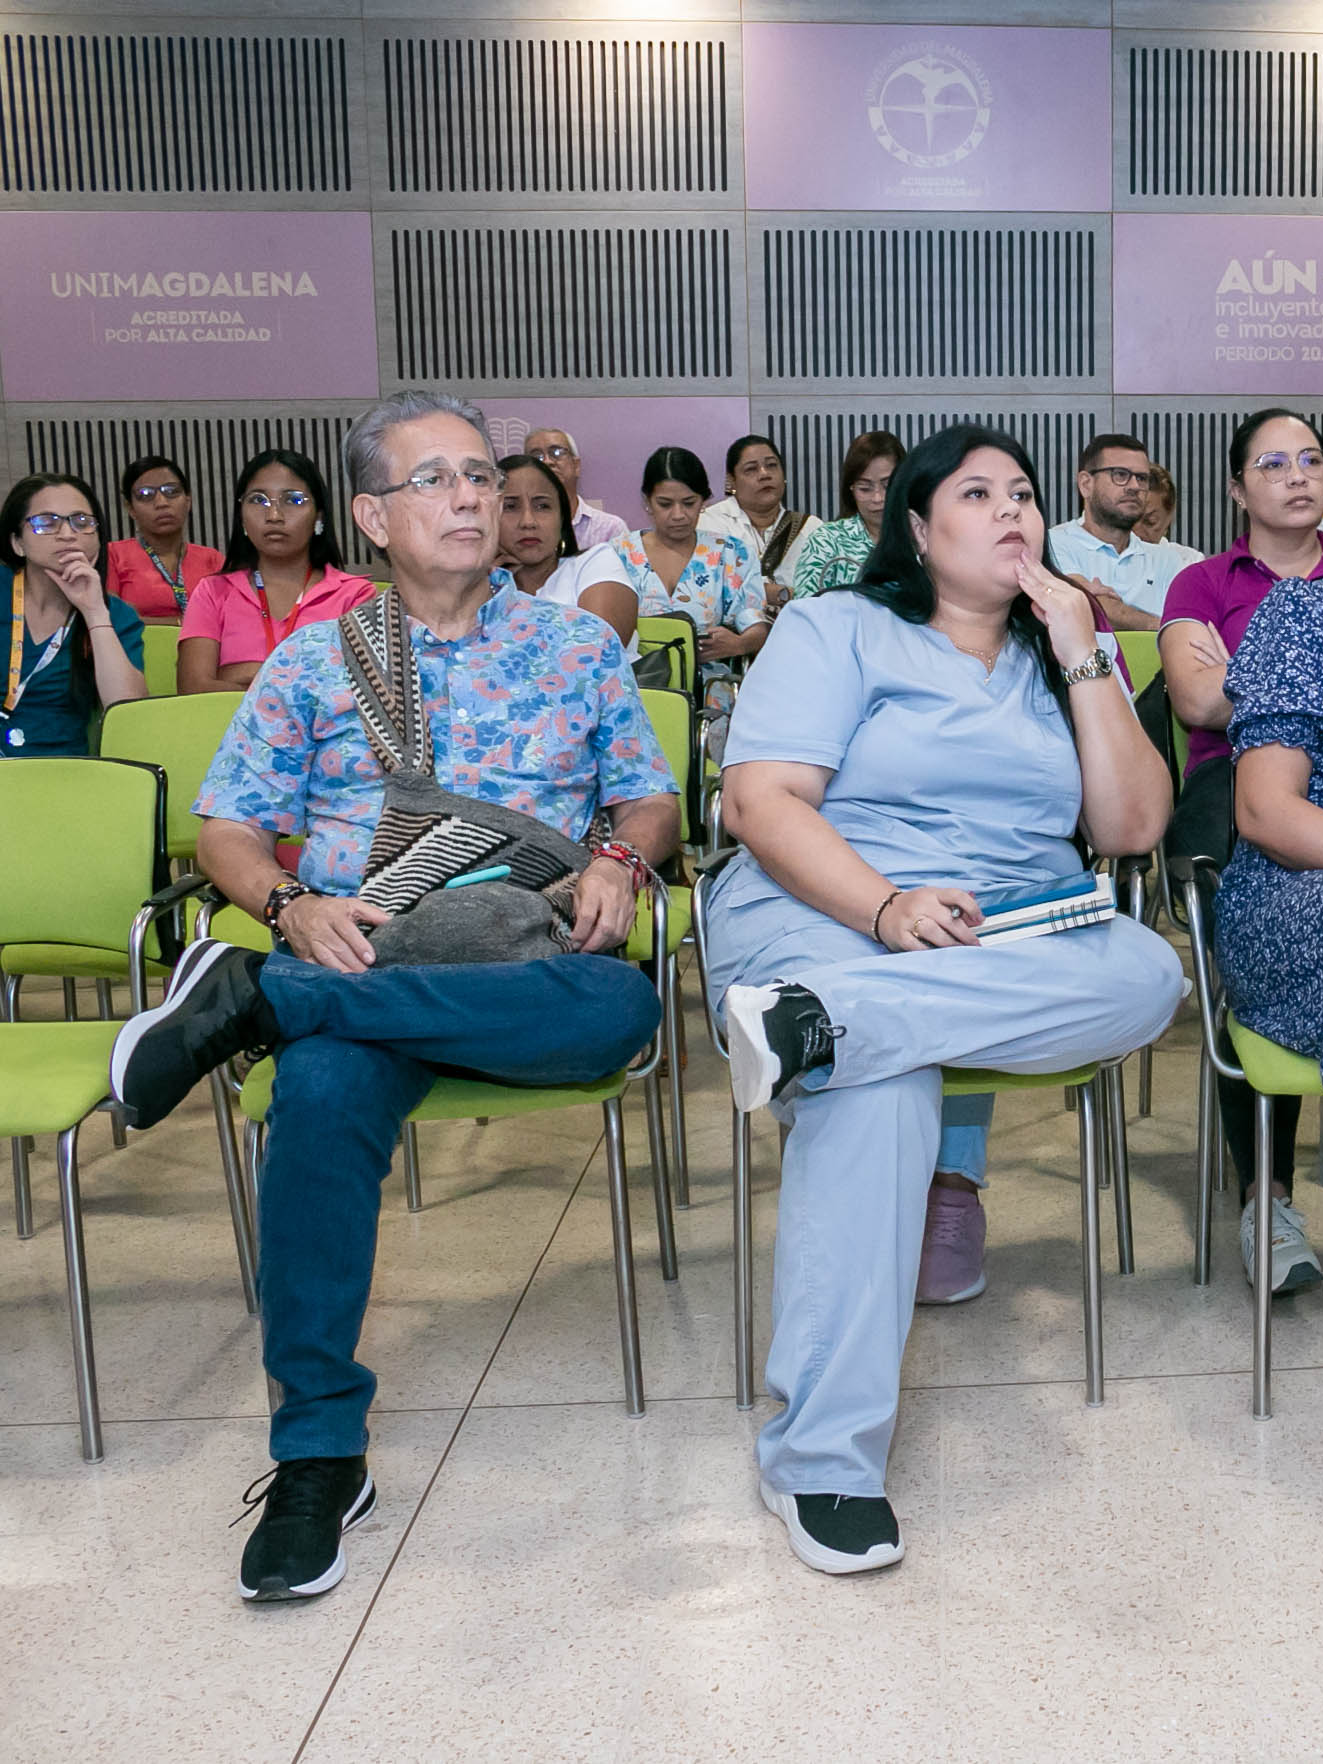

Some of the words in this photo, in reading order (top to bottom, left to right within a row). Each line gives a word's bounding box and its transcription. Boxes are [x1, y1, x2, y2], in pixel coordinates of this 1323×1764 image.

[1216, 250, 1316, 295] AÚN
[50, 272, 318, 298] UNIMAGDALENA
[131, 311, 246, 325] ACREDITADA
[105, 328, 142, 343] POR
[146, 327, 189, 343] ALTA
[192, 327, 272, 342] CALIDAD
[1216, 322, 1229, 338] e
[1215, 346, 1295, 361] PERIODO
